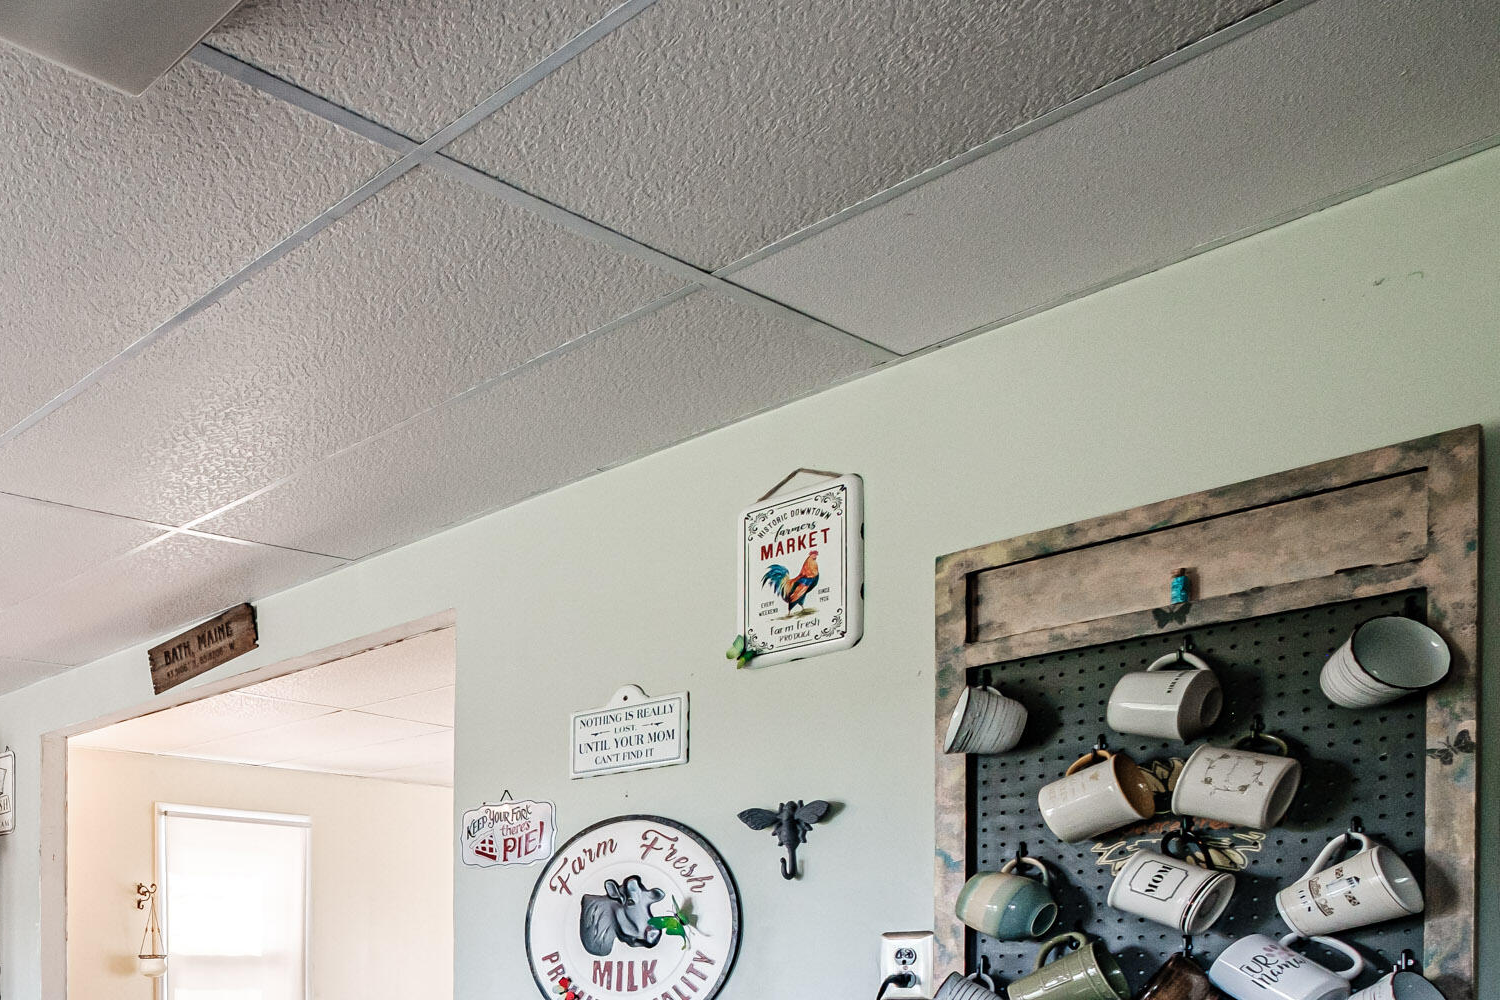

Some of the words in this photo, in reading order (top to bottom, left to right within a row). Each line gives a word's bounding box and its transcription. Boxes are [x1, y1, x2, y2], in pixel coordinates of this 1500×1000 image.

[757, 513, 788, 539] HISTORIC
[790, 506, 832, 521] DOWNTOWN
[774, 520, 817, 542] farmers
[760, 527, 830, 561] MARKET
[196, 621, 234, 650] MAINE
[580, 713, 622, 729] NOTHING
[625, 711, 634, 721] IS
[637, 703, 675, 719] REALLY
[579, 740, 610, 755] UNTIL
[614, 733, 644, 748] YOUR
[647, 728, 675, 744] MOM
[594, 753, 620, 765] CAN'T
[622, 750, 643, 761] FIND
[645, 748, 654, 757] IT
[466, 815, 488, 840] KEEP
[503, 820, 545, 862] PIE!
[549, 838, 618, 896] Farm
[640, 828, 714, 893] Fresh
[1144, 865, 1174, 897] MOM
[592, 959, 658, 992] MILK
[1239, 954, 1279, 978] FUR
